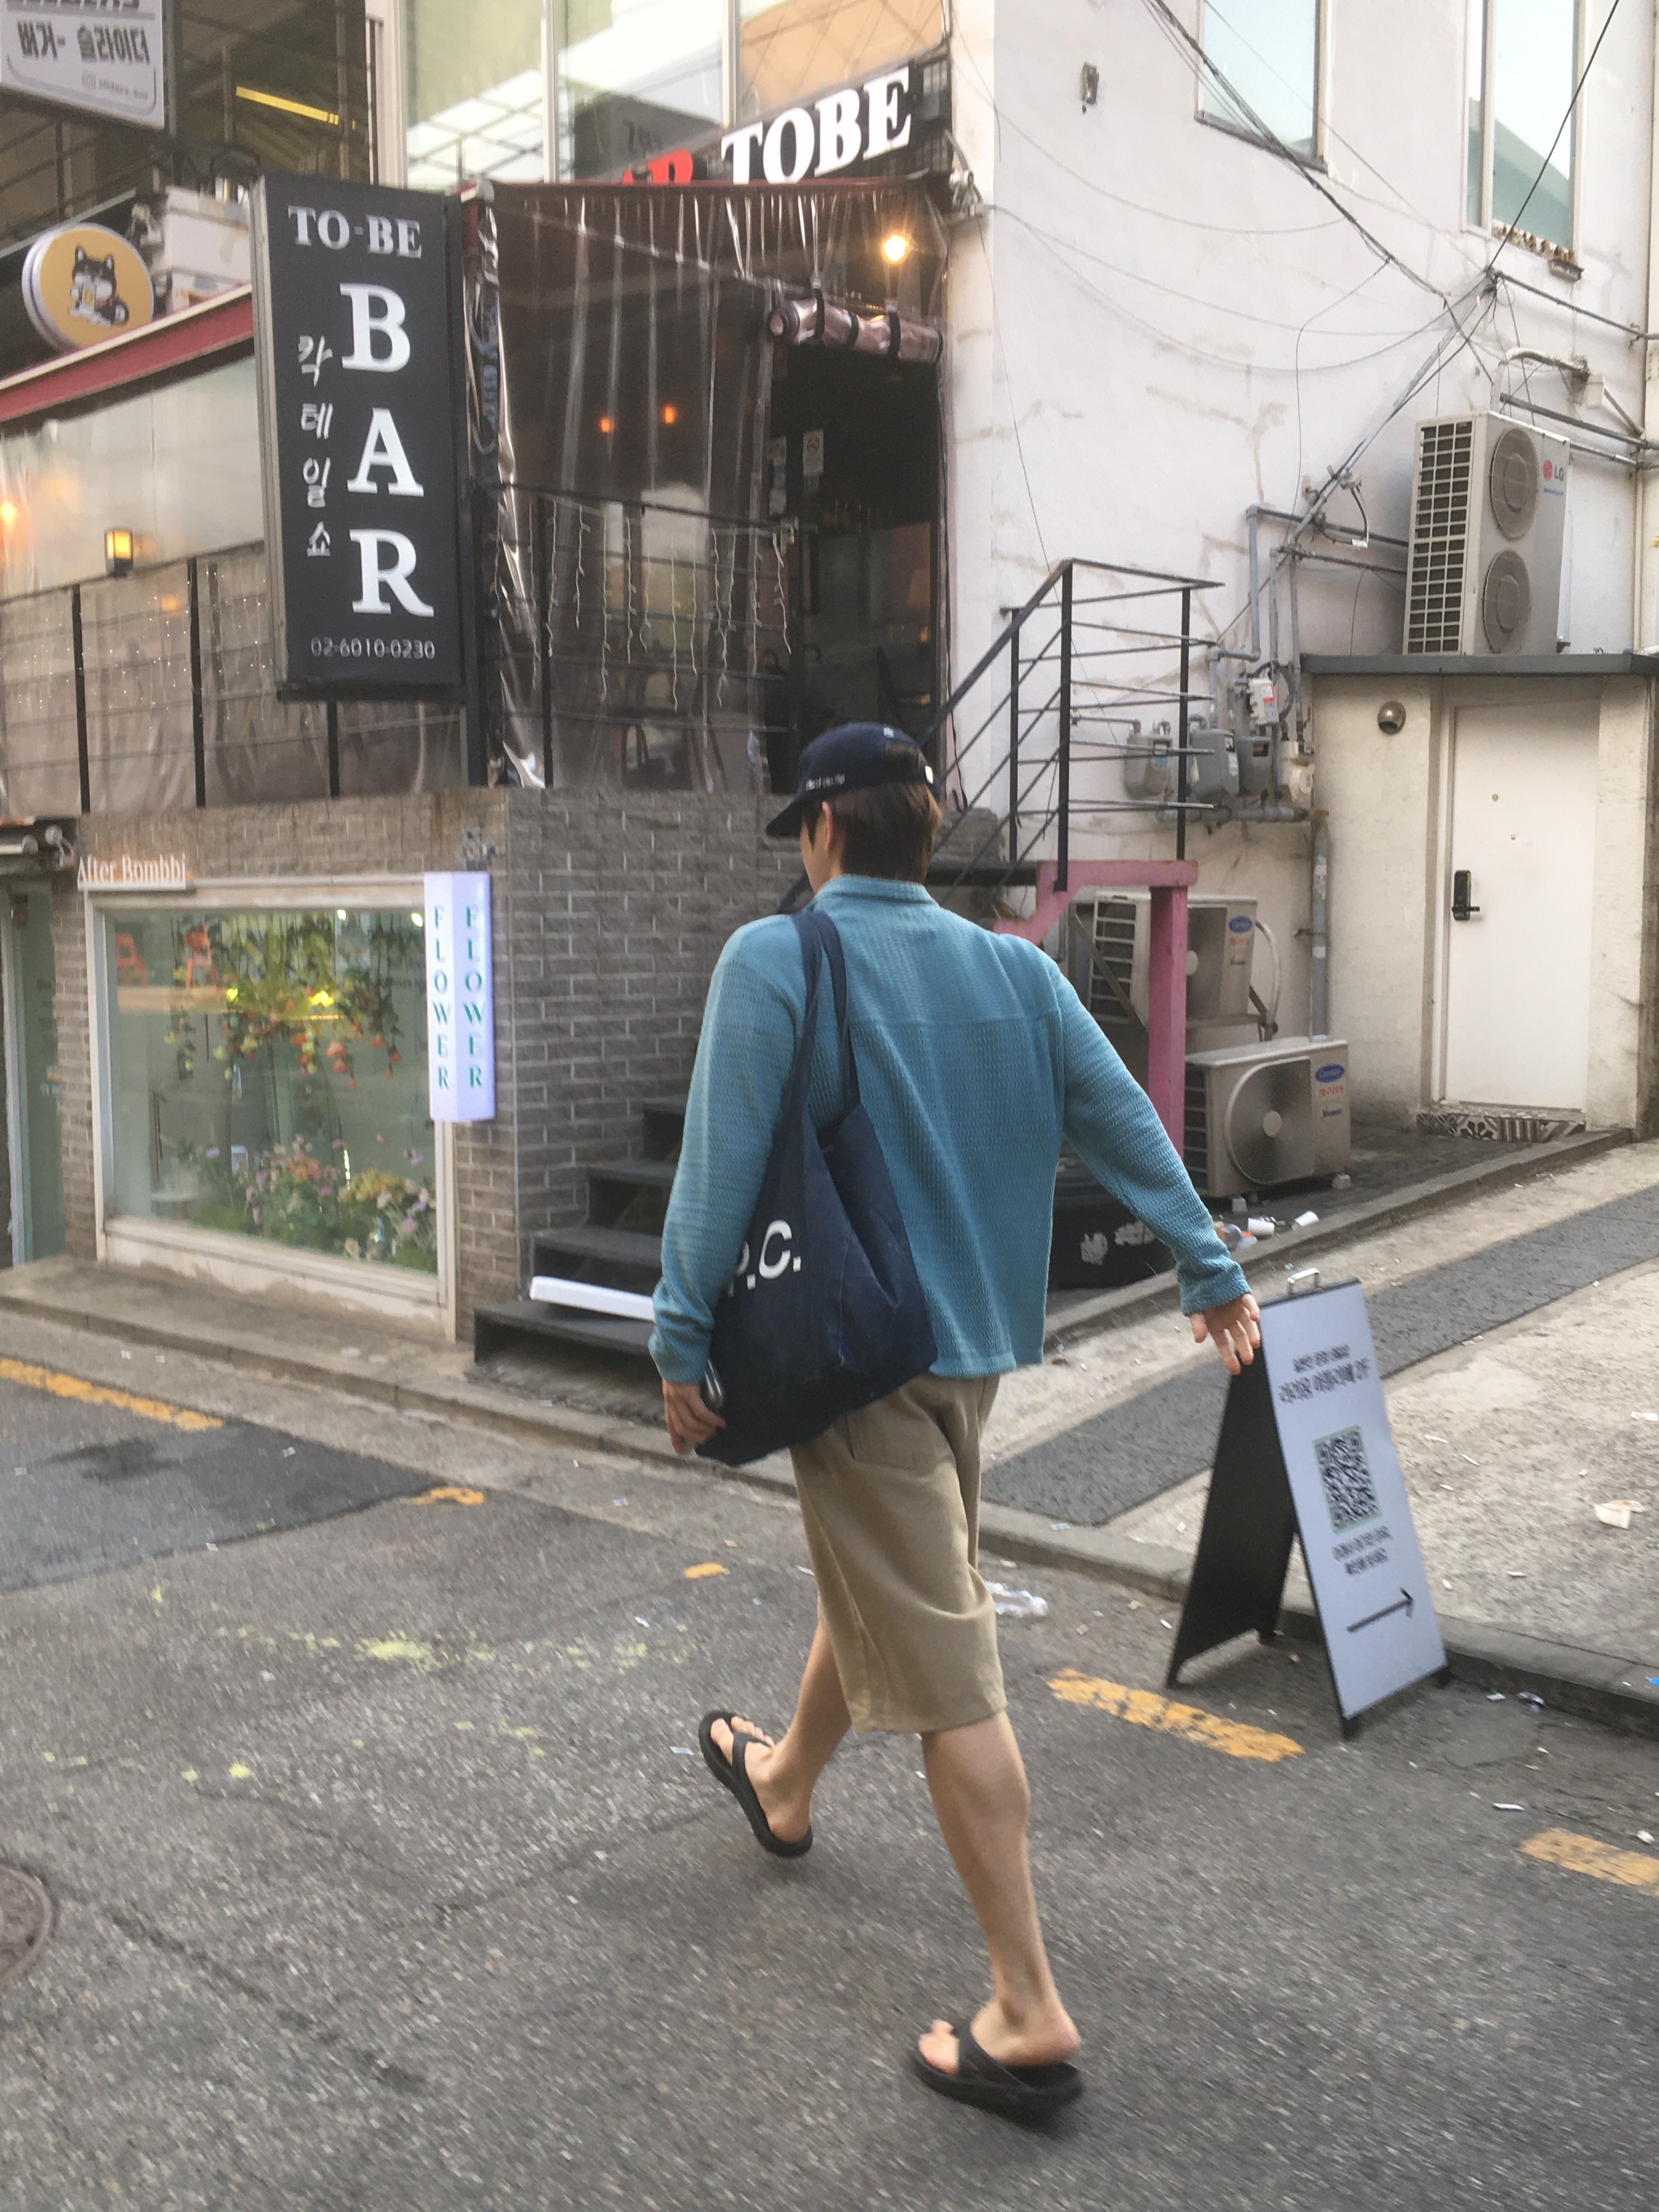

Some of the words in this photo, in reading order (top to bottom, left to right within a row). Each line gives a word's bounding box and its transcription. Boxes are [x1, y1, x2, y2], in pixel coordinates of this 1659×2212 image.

[77, 24, 150, 65] 슬라이더
[721, 65, 912, 185] TOBE
[287, 205, 422, 259] TO-BE
[339, 282, 435, 617] BAR
[311, 637, 435, 660] 02-6010-0230
[432, 904, 451, 1090] FLOWER
[462, 904, 487, 1089] FLOWER
